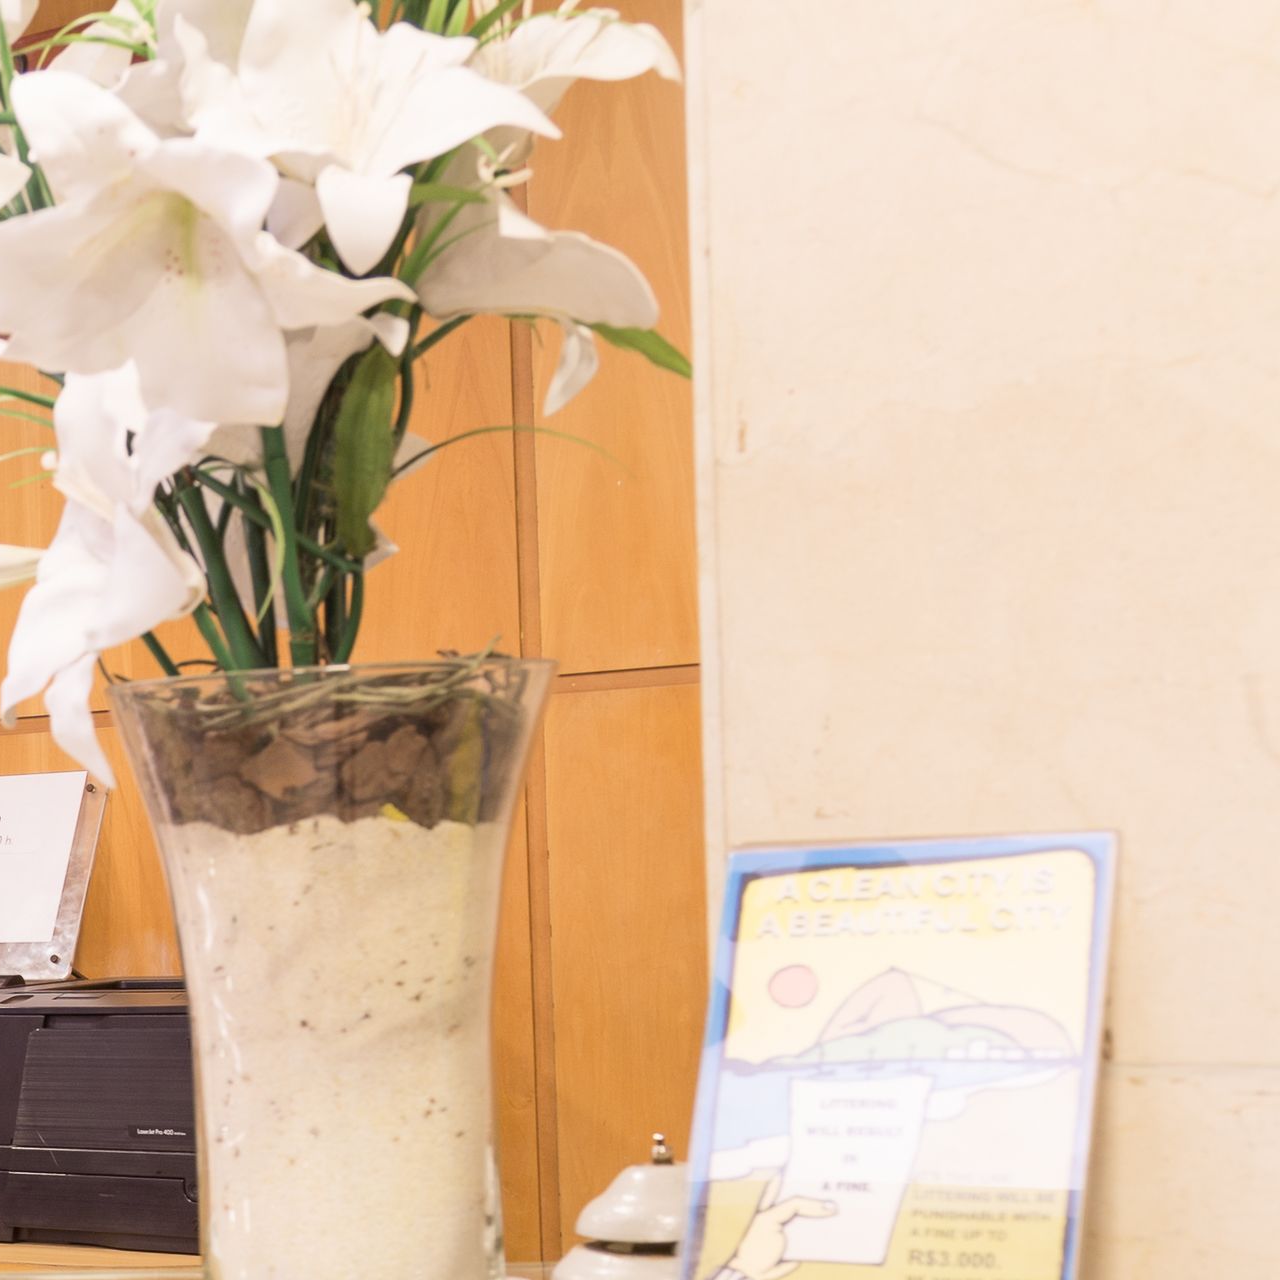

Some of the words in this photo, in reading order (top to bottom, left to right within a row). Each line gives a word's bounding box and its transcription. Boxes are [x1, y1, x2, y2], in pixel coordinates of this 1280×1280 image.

[776, 876, 802, 903] A
[805, 872, 926, 902] CLEAN
[933, 867, 1012, 897] CITY
[756, 911, 782, 938] A
[787, 905, 980, 938] BEAUTIFUL
[989, 903, 1070, 933] CITY
[924, 1227, 955, 1240] FINE
[988, 1230, 1008, 1242] TO
